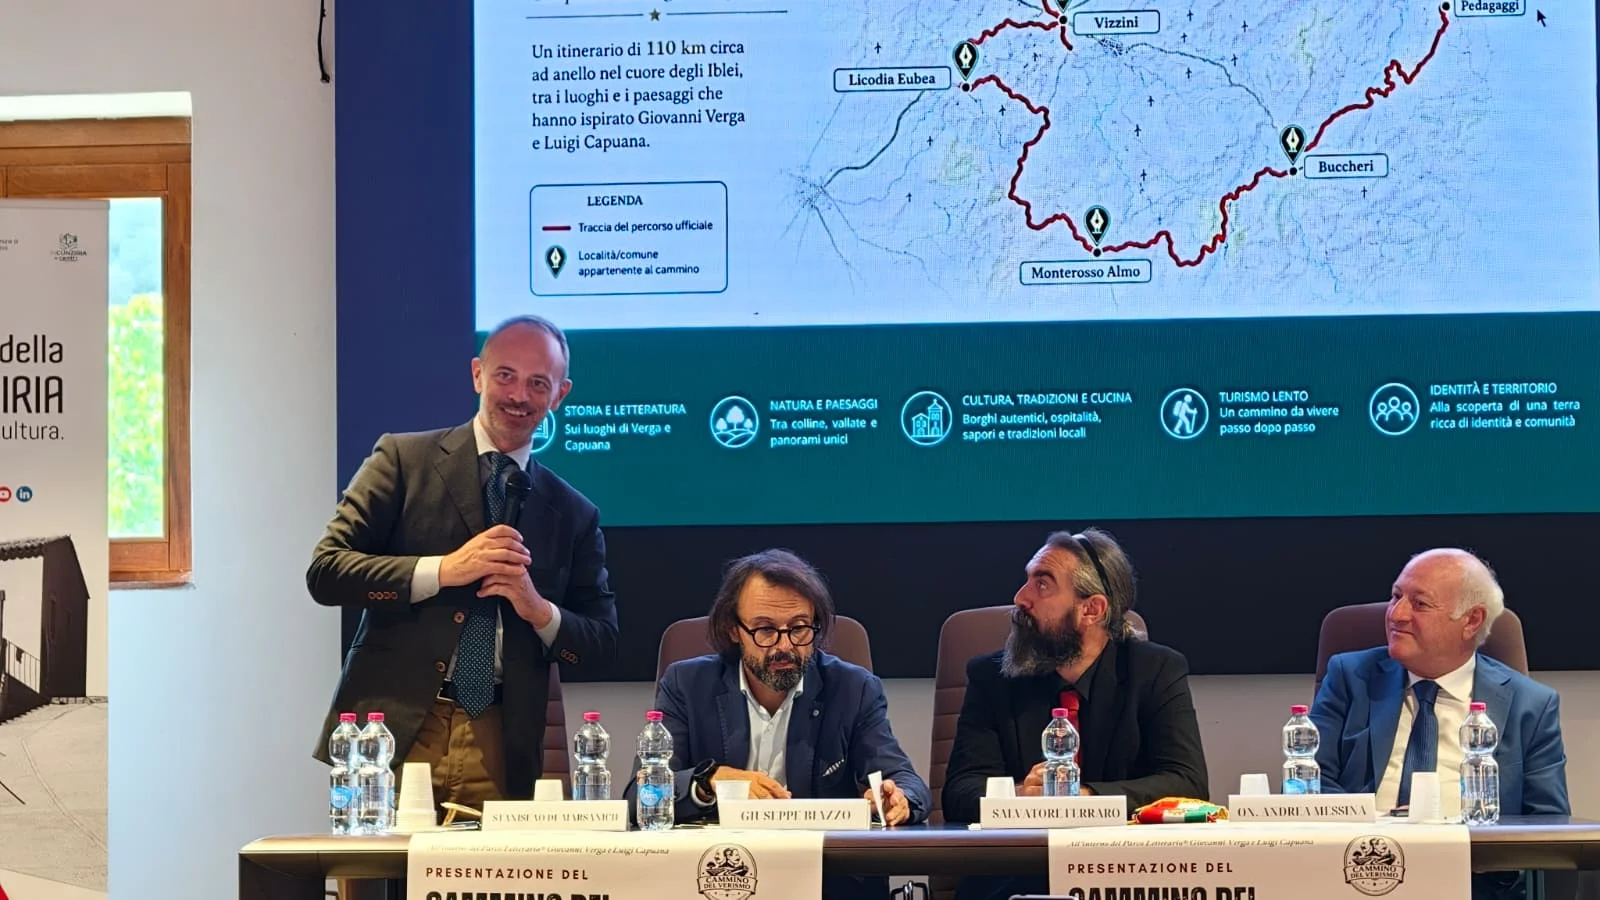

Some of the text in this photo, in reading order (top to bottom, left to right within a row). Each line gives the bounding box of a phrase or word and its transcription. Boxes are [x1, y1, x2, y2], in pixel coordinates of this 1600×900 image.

[1461, 0, 1519, 13] Pedagaggi
[1094, 16, 1139, 29] Vizzini
[532, 40, 744, 59] Un itinerario di 110 km circa
[532, 62, 744, 82] ad anello nel cuore degli Iblei,
[849, 72, 936, 86] Licodia Eubea
[532, 86, 723, 107] tra i luoghi e i paesaggi che
[532, 109, 745, 129] hanno ispirato Giovanni Verga
[532, 135, 650, 153] e Luigi Capuana.
[1318, 160, 1374, 173] Buccheri
[587, 195, 643, 207] LEGENDA
[578, 220, 713, 234] Traccia del percorso ufficiale
[578, 250, 659, 261] Località/comune
[578, 265, 699, 278] appartenente al cammino
[1031, 265, 1140, 279] Monterosso Almo
[0, 334, 63, 363] della
[1430, 382, 1557, 395] IDENTITÀ E TERRITORIO
[962, 392, 1132, 406] CULTURA, TRADIZIONI E CUCINA
[1219, 391, 1308, 402] TURISMO LENTO
[564, 404, 686, 416] STORIA E LETTERATURA
[770, 399, 877, 410] NATURA E PAESAGGI
[1430, 401, 1580, 413] Alla scoperta di una terra
[1220, 406, 1339, 417] Un cammino da vivere
[770, 417, 877, 430] Tra colline, vallate e
[962, 411, 1101, 426] Borghi autentici, ospitalità,
[1431, 415, 1576, 428] ricca di identità e comunità
[0, 421, 64, 440] ultura.
[564, 423, 581, 434] Sui
[584, 422, 616, 436] luoghi
[619, 422, 629, 433] di
[632, 423, 662, 436] Verga
[962, 427, 1086, 440] sapori e tradizioni locali
[1220, 422, 1315, 435] passo dopo passo
[565, 440, 610, 452] Capuana
[770, 433, 848, 448] panorami unici
[741, 810, 800, 821] GIUSEPPE
[992, 808, 1120, 819] SALVATORE FERRARO
[1237, 805, 1367, 817] ON. ANDREA MESSINA
[1280, 839, 1314, 847] Capuana
[635, 847, 669, 856] Capuana
[426, 867, 589, 880] PRESENTAZIONE DEL
[1068, 862, 1233, 874] PRESENTAZIONE DEL
[1352, 865, 1397, 873] CAMMINO
[706, 876, 749, 884] CAMMINO
